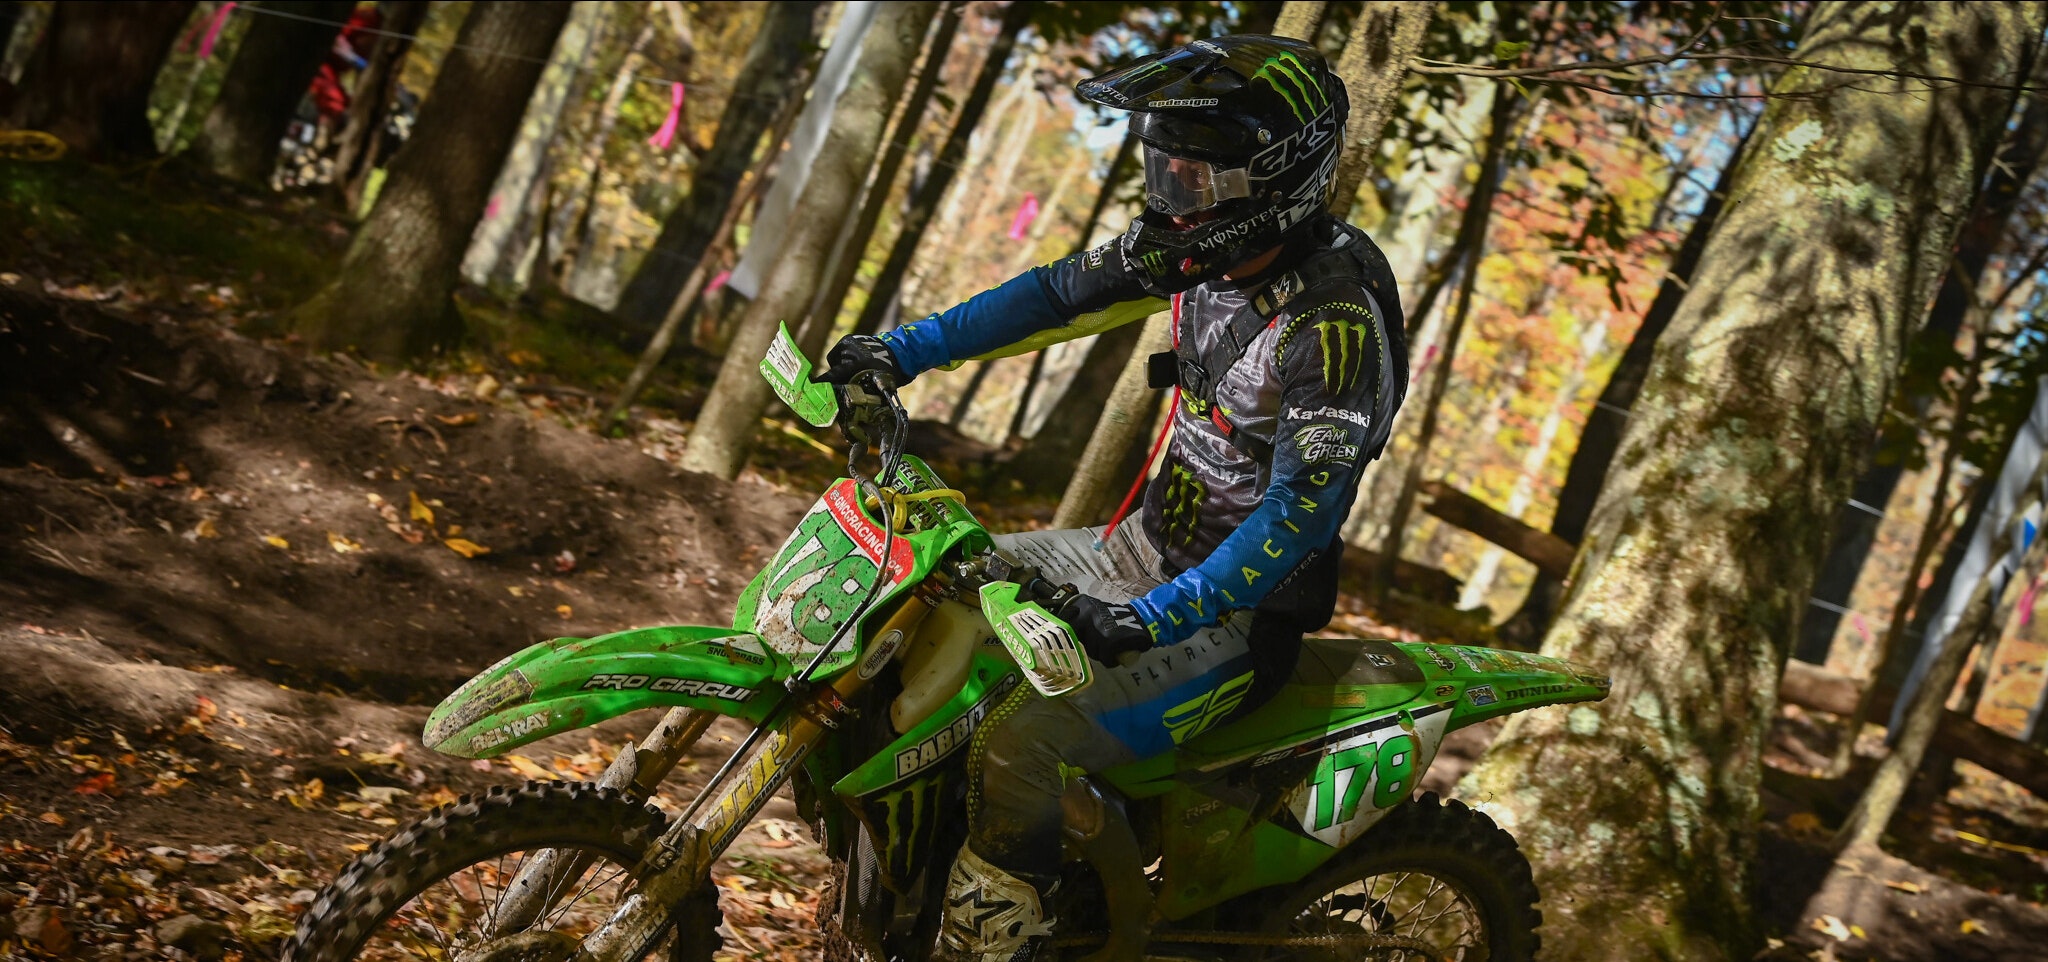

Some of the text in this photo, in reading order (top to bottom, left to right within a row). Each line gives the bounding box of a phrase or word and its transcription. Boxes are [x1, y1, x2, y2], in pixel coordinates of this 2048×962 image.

[767, 509, 879, 646] 178
[1107, 606, 1143, 630] LY
[584, 673, 651, 691] PRO
[1307, 735, 1416, 832] 178
